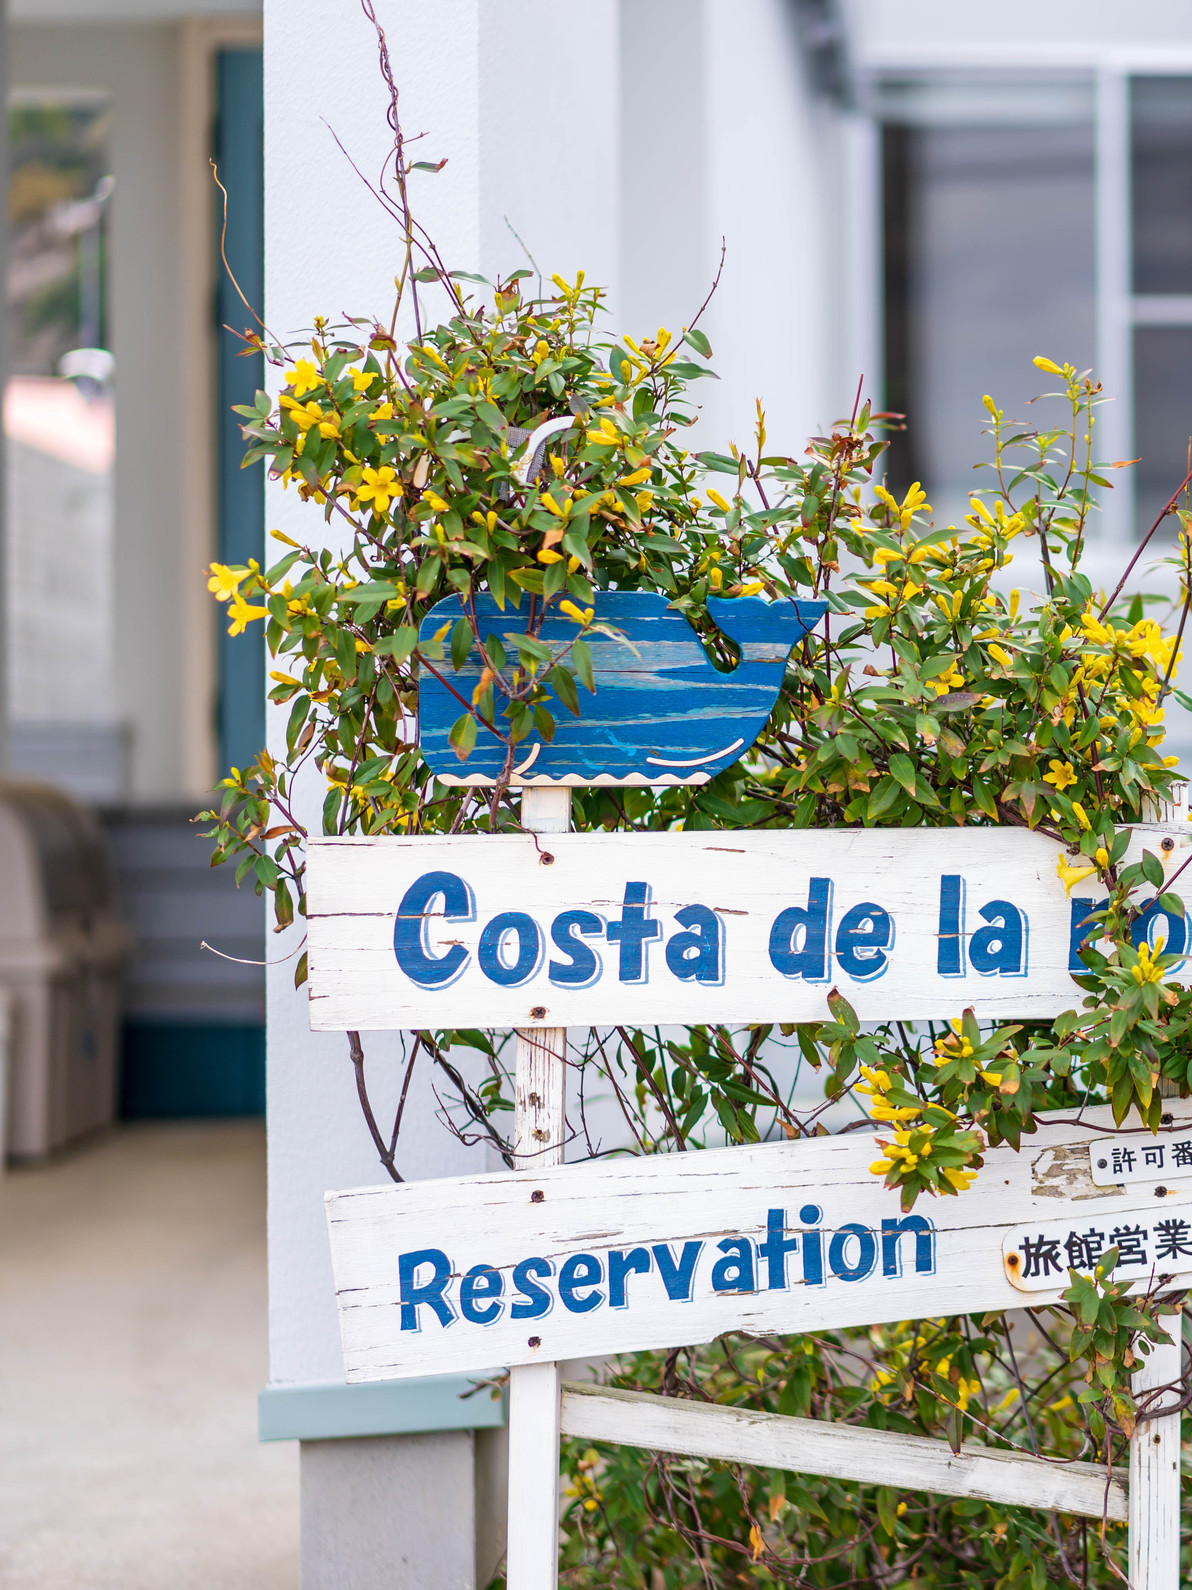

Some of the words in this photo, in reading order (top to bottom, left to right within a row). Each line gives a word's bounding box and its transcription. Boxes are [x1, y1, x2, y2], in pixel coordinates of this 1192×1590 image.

[393, 870, 726, 991] Costa
[769, 876, 896, 984] de
[937, 874, 1030, 978] la
[398, 1203, 936, 1333] Reservation
